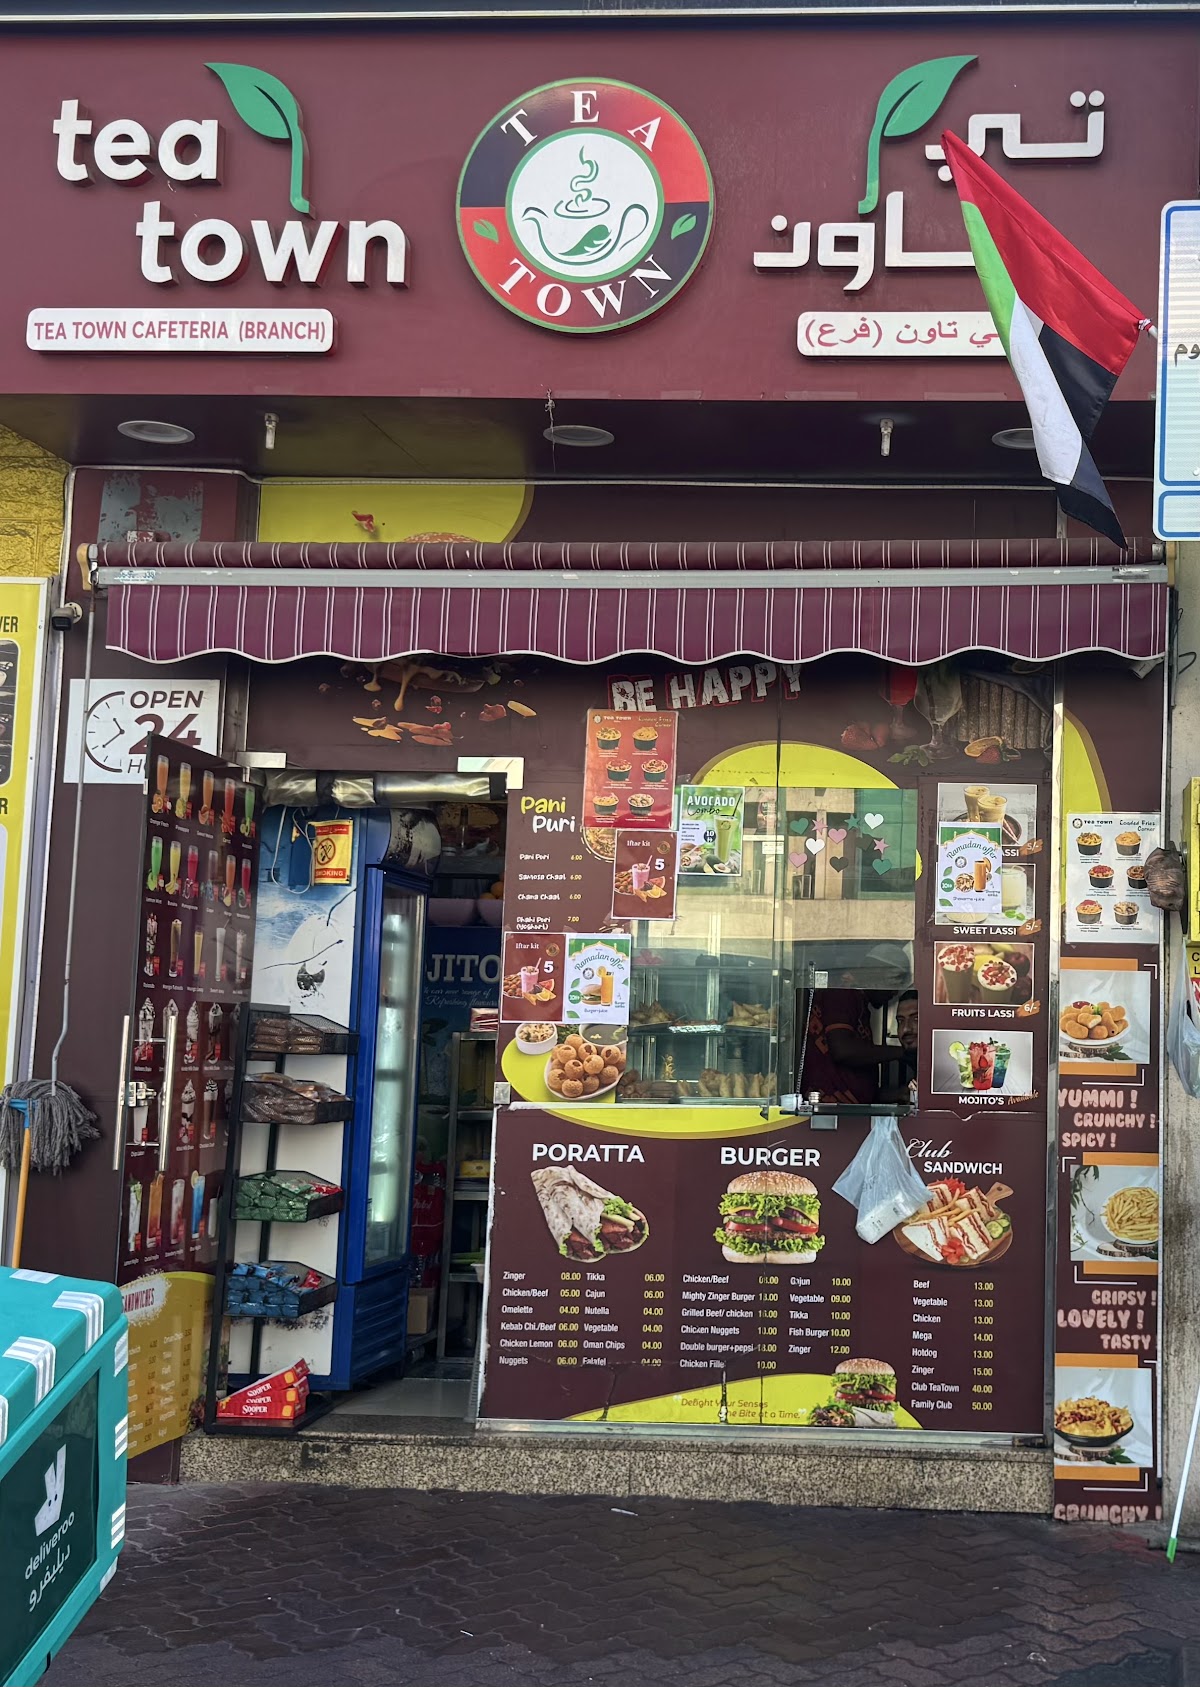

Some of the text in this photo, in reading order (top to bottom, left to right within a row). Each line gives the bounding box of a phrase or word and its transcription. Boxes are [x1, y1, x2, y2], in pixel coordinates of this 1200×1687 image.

[500, 90, 661, 152] TEA
[53, 99, 218, 181] tea
[136, 200, 406, 283] town
[753, 191, 976, 290] اون
[498, 254, 672, 318] TOWN
[34, 320, 325, 343] TEA TOWN CAFETERIA (BRANCH)
[805, 316, 999, 348] ي تاون (فرع)
[612, 662, 800, 711] BE HAPPY
[130, 690, 204, 709] OPEN
[128, 759, 147, 773] H
[521, 796, 566, 814] Pani
[687, 795, 736, 806] AVOCADO
[687, 802, 721, 816] Combo
[533, 815, 575, 833] Puri
[946, 840, 982, 859] Ramadan
[655, 858, 665, 870] 5
[953, 926, 1016, 935] SWEET LASSI
[544, 961, 554, 973] 5
[575, 952, 609, 971] Ramadan
[425, 954, 501, 983] JITO
[952, 1008, 1015, 1018] FRUITS LASSI
[959, 1096, 1005, 1105] MOJITO'S
[1058, 1088, 1138, 1109] YUMMI !
[1074, 1112, 1156, 1129] CRUNCHY !
[1062, 1132, 1117, 1148] SPICY !
[532, 1143, 645, 1163] PORATTA
[905, 1138, 953, 1158] Club
[720, 1146, 821, 1166] BURGER
[924, 1161, 1003, 1175] SANDWICH
[503, 1271, 581, 1281] Zinger 08.00
[586, 1272, 665, 1282] Tikka 06.00
[682, 1274, 729, 1283] Chicken/Beef
[832, 1278, 852, 1286] 10.00
[913, 1280, 994, 1290] Beef 13.00
[502, 1288, 580, 1297] Chicken/Beef 05.00
[585, 1289, 664, 1299] Cajun 06.00
[682, 1291, 756, 1302] Mighty Zinger Burger
[1091, 1290, 1146, 1306] CRIPSY
[789, 1293, 851, 1304] Vegetable 09.00
[913, 1297, 993, 1307] Vegetable 13.00
[501, 1305, 579, 1314] Omelette 04.00
[584, 1306, 664, 1316] Nutella 04.00
[681, 1308, 753, 1318] Grilled Beef/ chicken
[789, 1310, 851, 1320] Tikka 10.00
[912, 1314, 993, 1324] Chicken 13.00
[1057, 1309, 1144, 1329] LOVELY !
[501, 1322, 523, 1330] Kebab
[558, 1323, 579, 1331] 06.00
[584, 1323, 663, 1333] Vegetable 04.00
[681, 1325, 709, 1334] Chicken
[710, 1326, 740, 1336] Nuggets
[789, 1327, 850, 1338] Fish Burger 10.00
[912, 1331, 993, 1342] Mega 14.00
[500, 1339, 578, 1348] Chicken Lemon 06.00
[583, 1340, 662, 1350] Oman Chips 04.00
[680, 1342, 754, 1353] Double burger+pepsi
[1100, 1334, 1151, 1350] TASTY
[788, 1344, 850, 1354] Zinger 12.00
[912, 1348, 993, 1359] Hotdog 13.00
[499, 1356, 577, 1366] Nuggets 06.00
[680, 1359, 708, 1368] Chicken
[911, 1365, 993, 1376] Zinger 15.00
[911, 1382, 993, 1393] Club TeaTown 40.00
[681, 1399, 713, 1408] Delight
[911, 1400, 993, 1410] Family Club 50.00
[779, 1410, 800, 1419] Time.
[1054, 1503, 1148, 1524] CRUNCHY
[25, 1511, 75, 1579] deliveroo
[29, 1545, 70, 1612] ديليفرو
